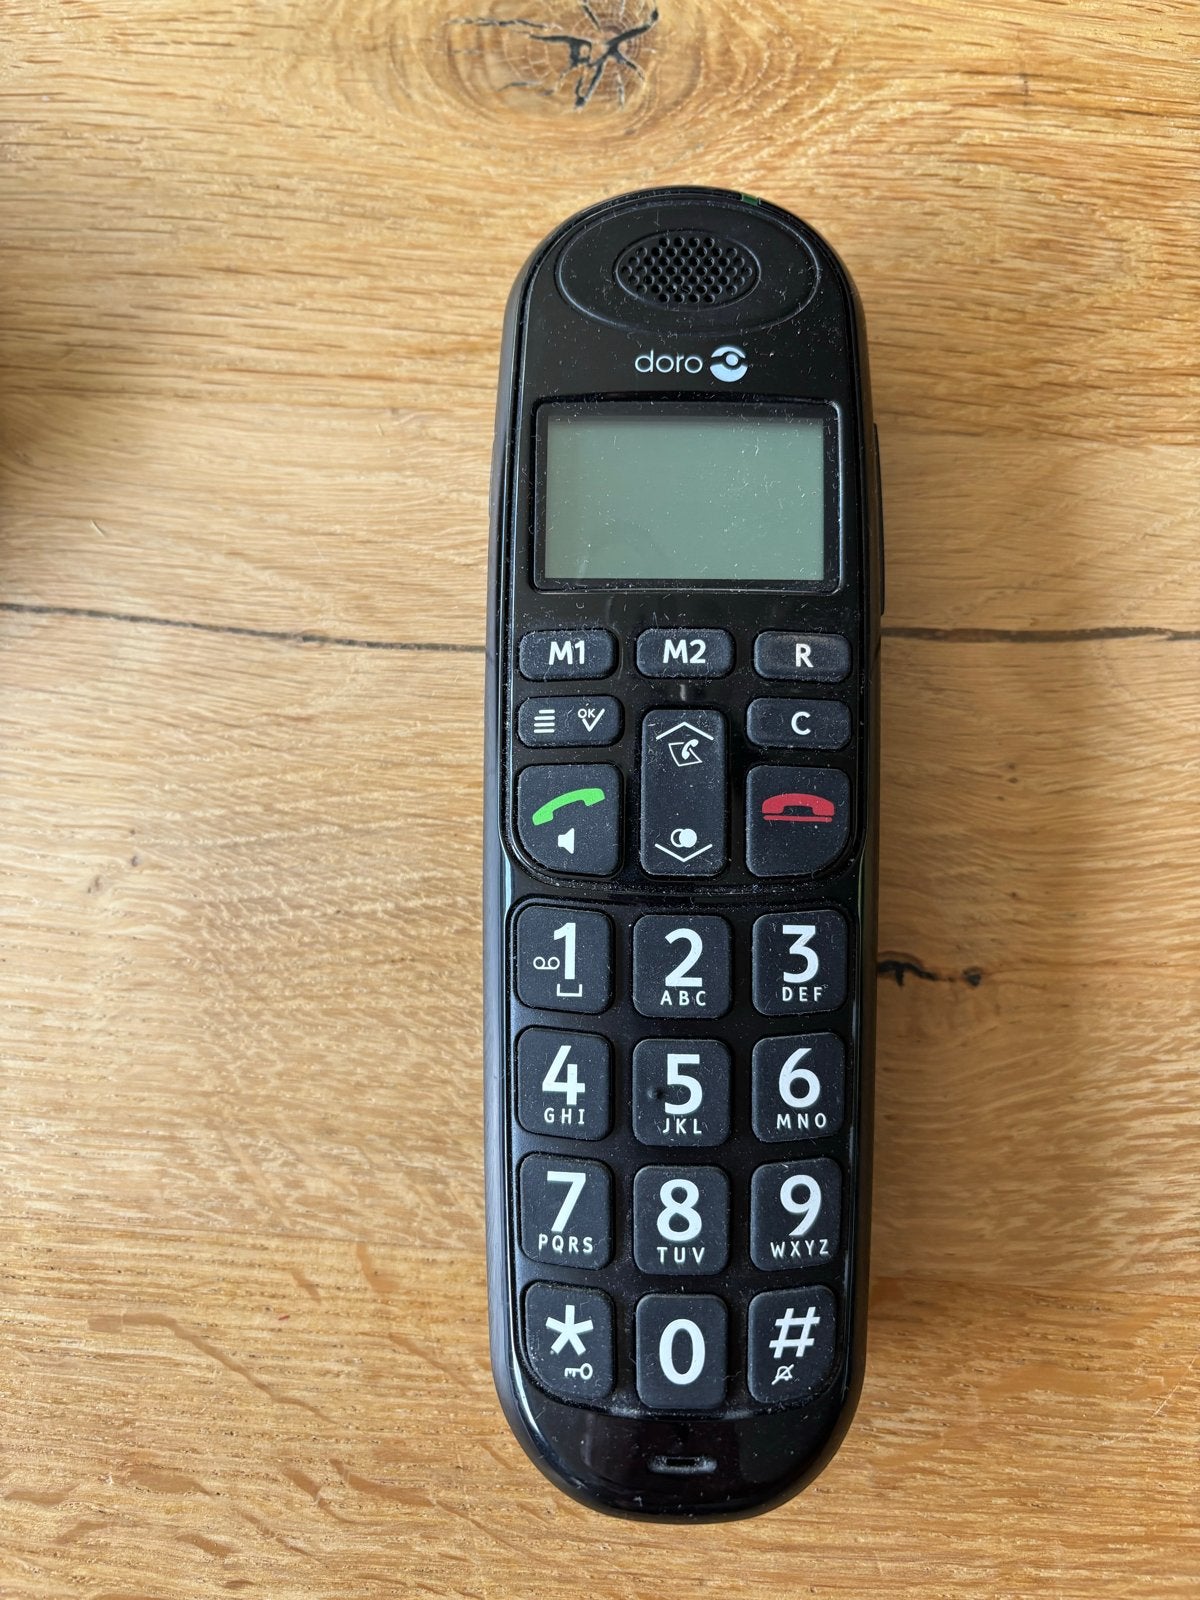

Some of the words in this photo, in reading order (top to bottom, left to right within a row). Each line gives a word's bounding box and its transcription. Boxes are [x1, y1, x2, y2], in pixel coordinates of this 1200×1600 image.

[635, 350, 703, 373] doro
[548, 640, 585, 665] M1
[663, 639, 706, 664] M2
[796, 643, 814, 667] R
[577, 707, 596, 720] OK
[791, 712, 811, 735] C
[553, 922, 576, 980] 1
[665, 928, 702, 987] 2
[783, 925, 818, 983] 3
[660, 990, 706, 1006] ABC
[782, 987, 822, 1001] DEF
[542, 1045, 585, 1106] 4
[665, 1054, 702, 1116] 5
[779, 1048, 820, 1108] 6
[544, 1107, 585, 1125] GHI
[663, 1118, 702, 1134] JKL
[777, 1113, 826, 1129] MNO
[547, 1171, 586, 1233] 7
[657, 1179, 702, 1242] 8
[780, 1175, 821, 1236] 9
[538, 1233, 593, 1254] PQRS
[657, 1247, 705, 1264] TUV
[771, 1239, 828, 1258] WXYZ
[769, 1307, 820, 1358] #
[659, 1319, 705, 1385] 0
